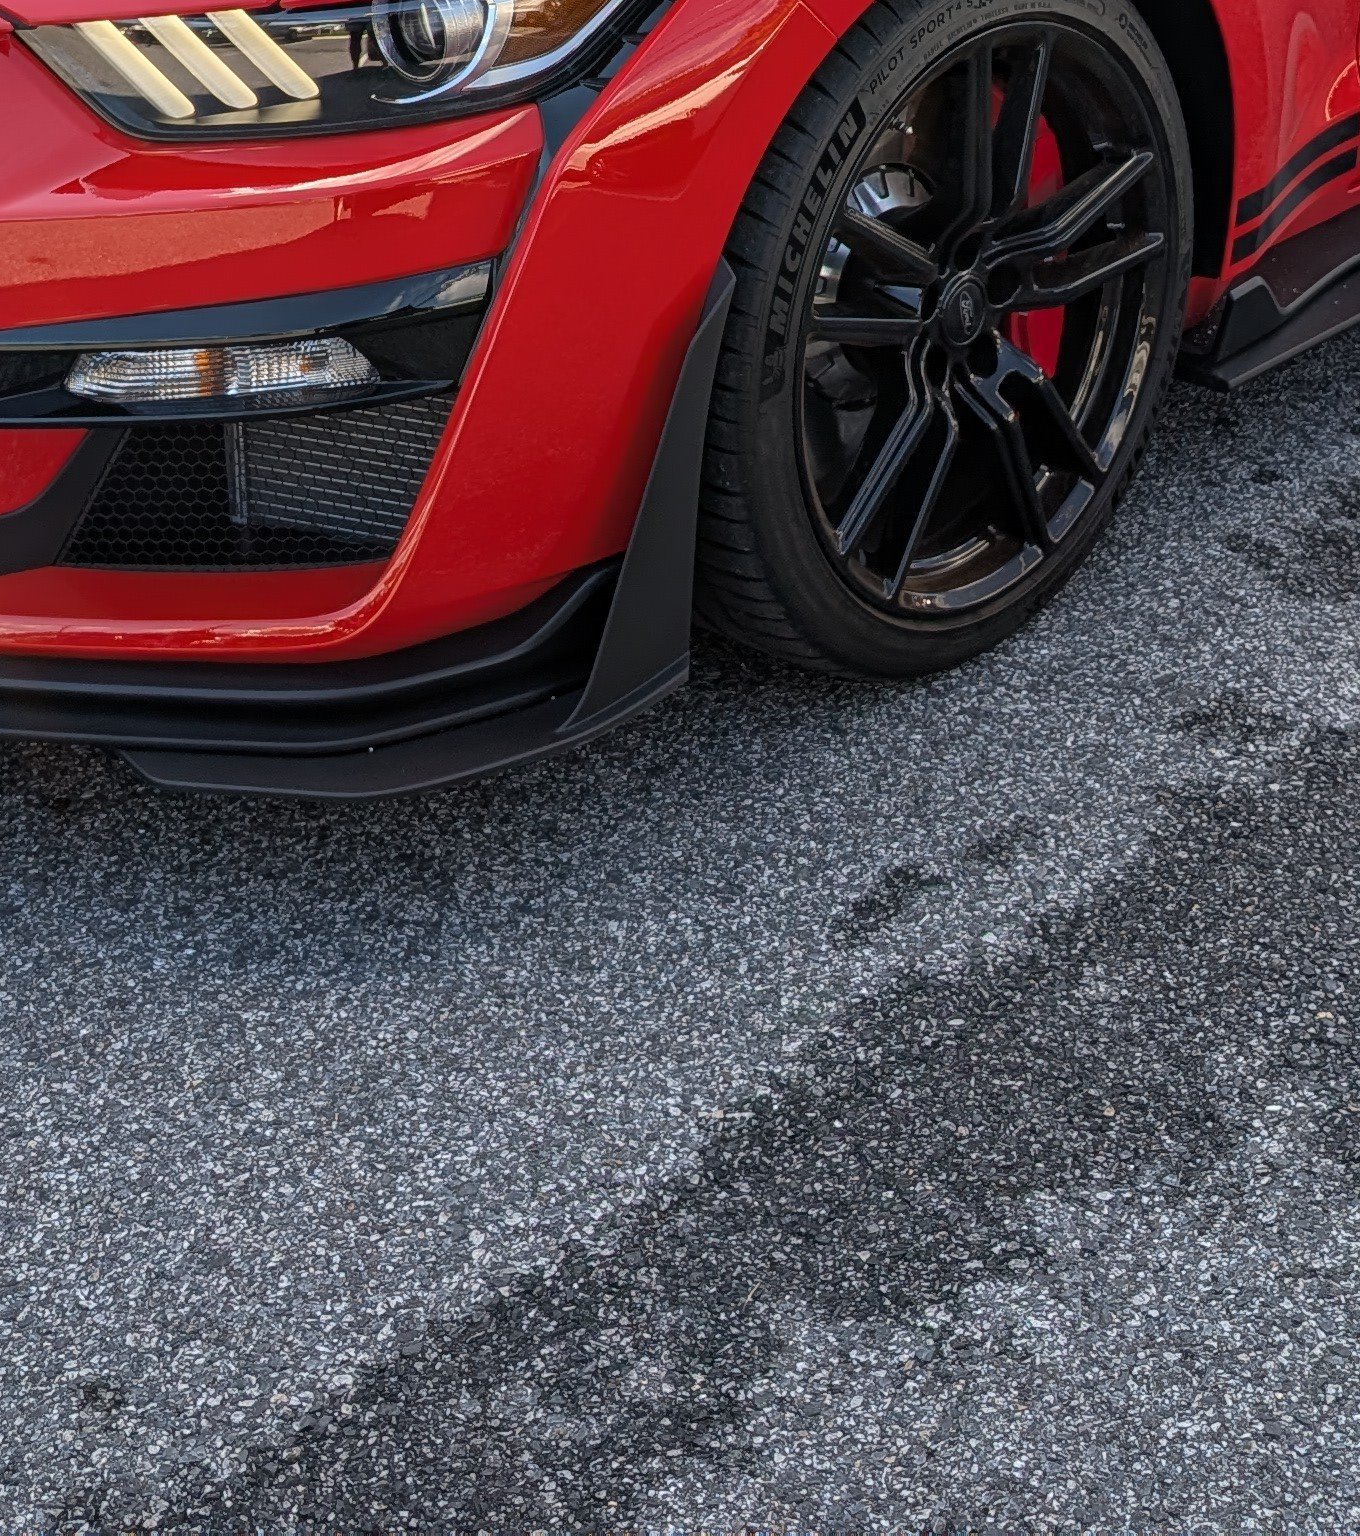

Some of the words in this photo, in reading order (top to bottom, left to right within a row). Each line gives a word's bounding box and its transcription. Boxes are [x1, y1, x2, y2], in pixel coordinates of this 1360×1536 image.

[769, 110, 859, 337] MICHELIN
[868, 46, 905, 95] PILOT
[909, 5, 954, 50] SPORT
